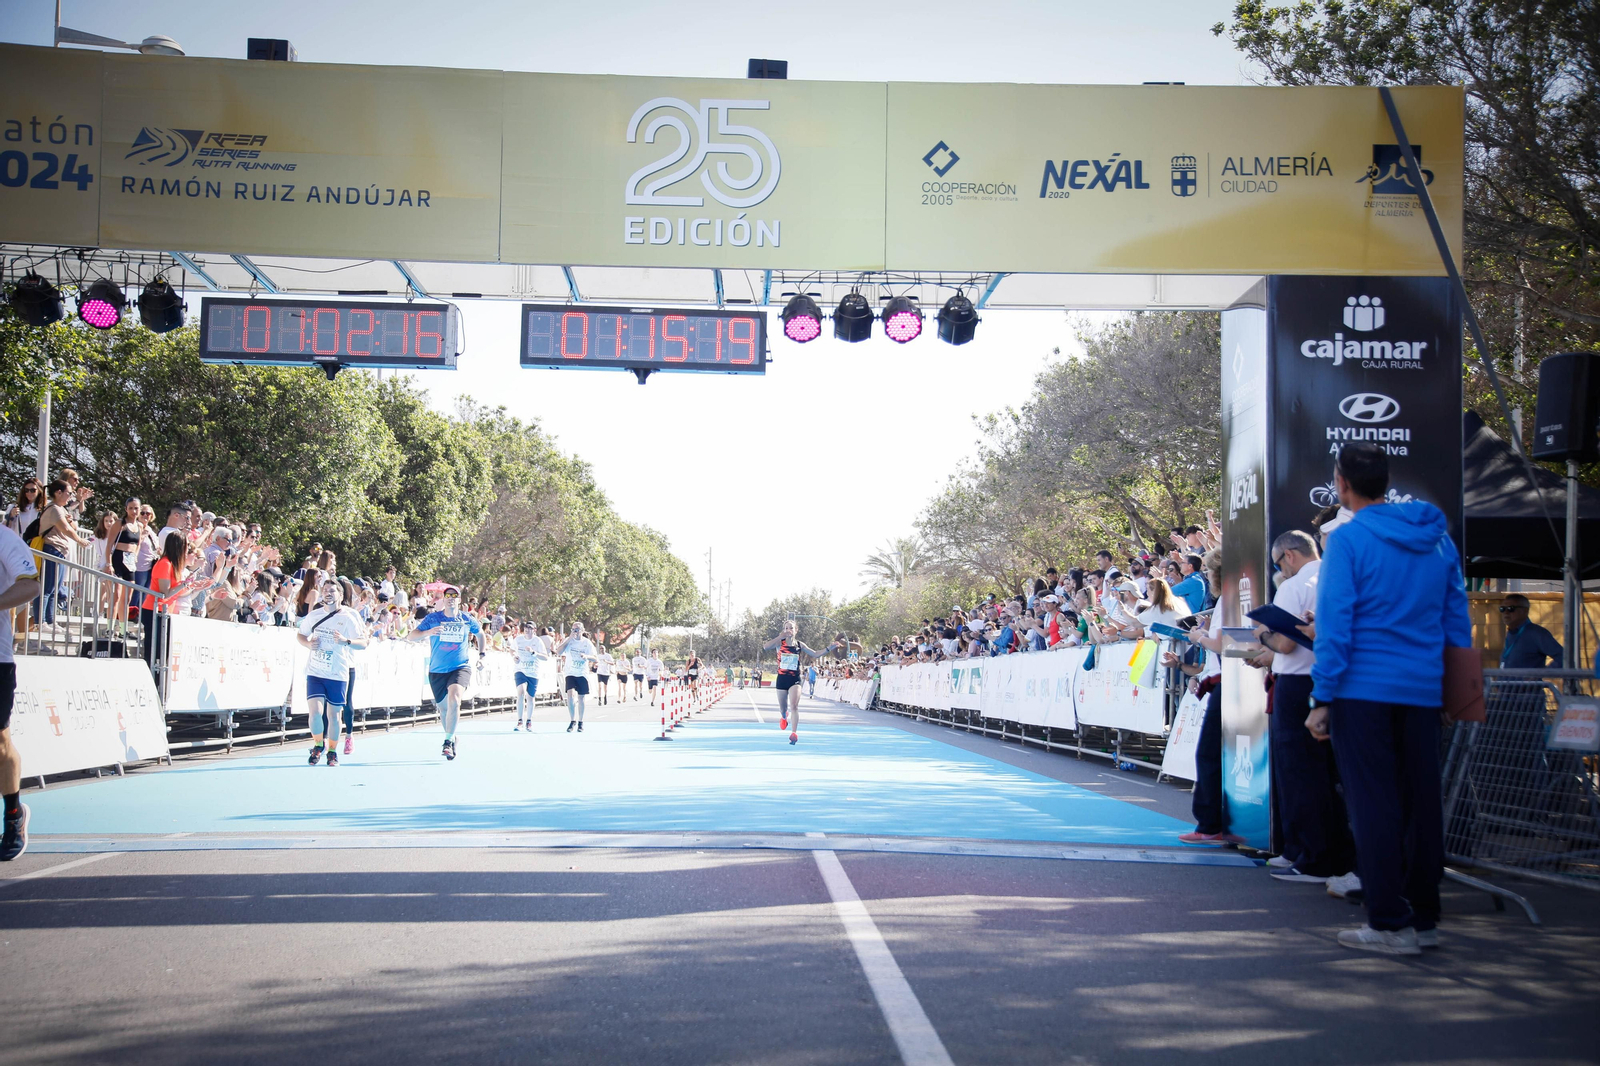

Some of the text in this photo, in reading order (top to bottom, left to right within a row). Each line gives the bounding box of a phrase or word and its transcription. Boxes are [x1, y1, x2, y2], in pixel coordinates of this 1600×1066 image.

[4, 115, 93, 146] atón
[204, 132, 268, 148] RFEA
[197, 147, 261, 160] SERIES
[625, 96, 782, 208] 25
[0, 150, 93, 191] 024
[191, 159, 297, 172] RUTA RUNNING
[1221, 152, 1333, 177] ALMERÍA
[121, 175, 431, 207] RAMÓN RUIZ ANDÚJAR
[921, 181, 1016, 195] COOPERACIÓN
[1220, 180, 1278, 193] CIUDAD
[921, 194, 953, 206] 2005
[1048, 191, 1070, 199] 2020
[1364, 200, 1410, 209] DEPORTES
[624, 212, 780, 247] EDICIÓN
[560, 312, 755, 365] 01:15:19
[1300, 332, 1428, 366] cajamar
[1361, 360, 1424, 370] CAJA RURAL
[1326, 427, 1411, 442] HYUNDAI
